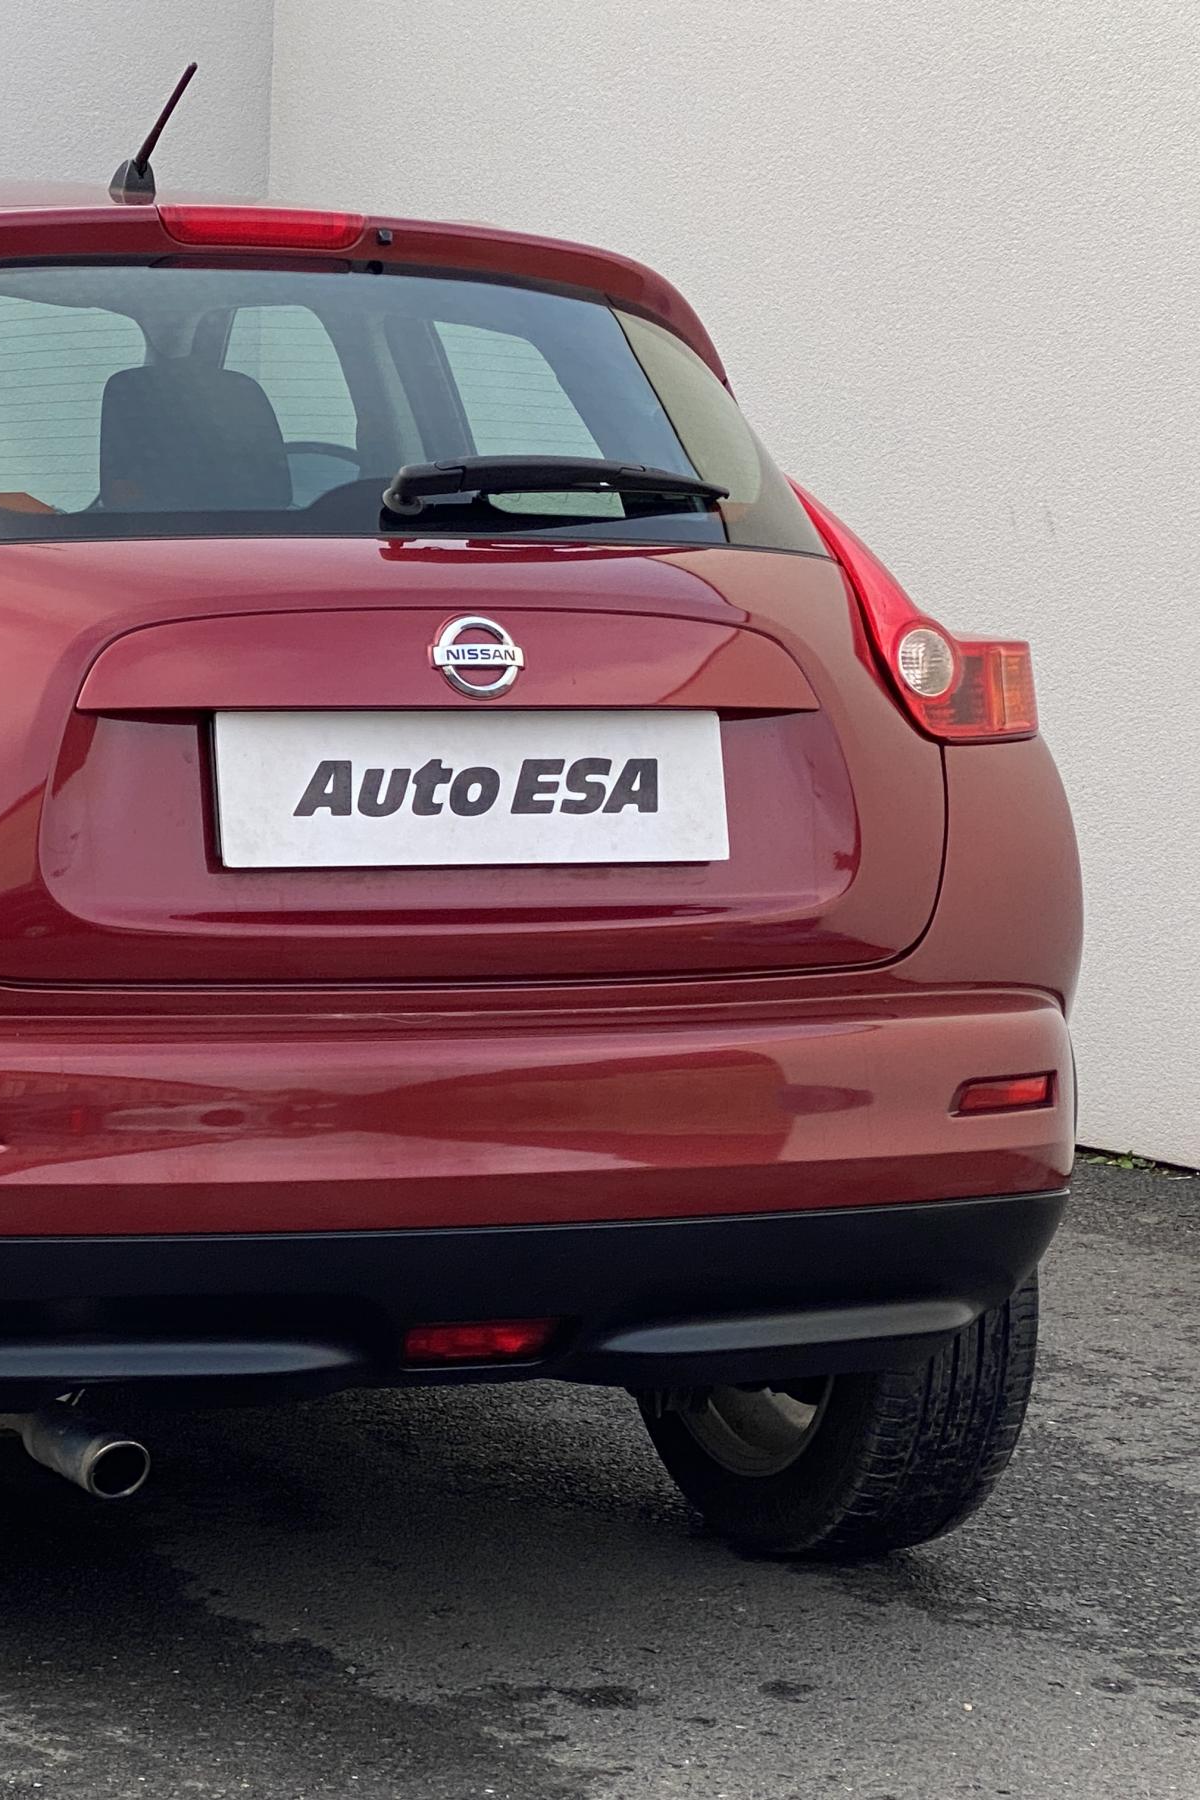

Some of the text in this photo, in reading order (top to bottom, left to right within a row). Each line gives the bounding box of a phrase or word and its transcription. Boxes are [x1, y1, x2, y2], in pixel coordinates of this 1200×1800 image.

[445, 648, 516, 662] NISSAN
[293, 757, 659, 817] Auto ESA
